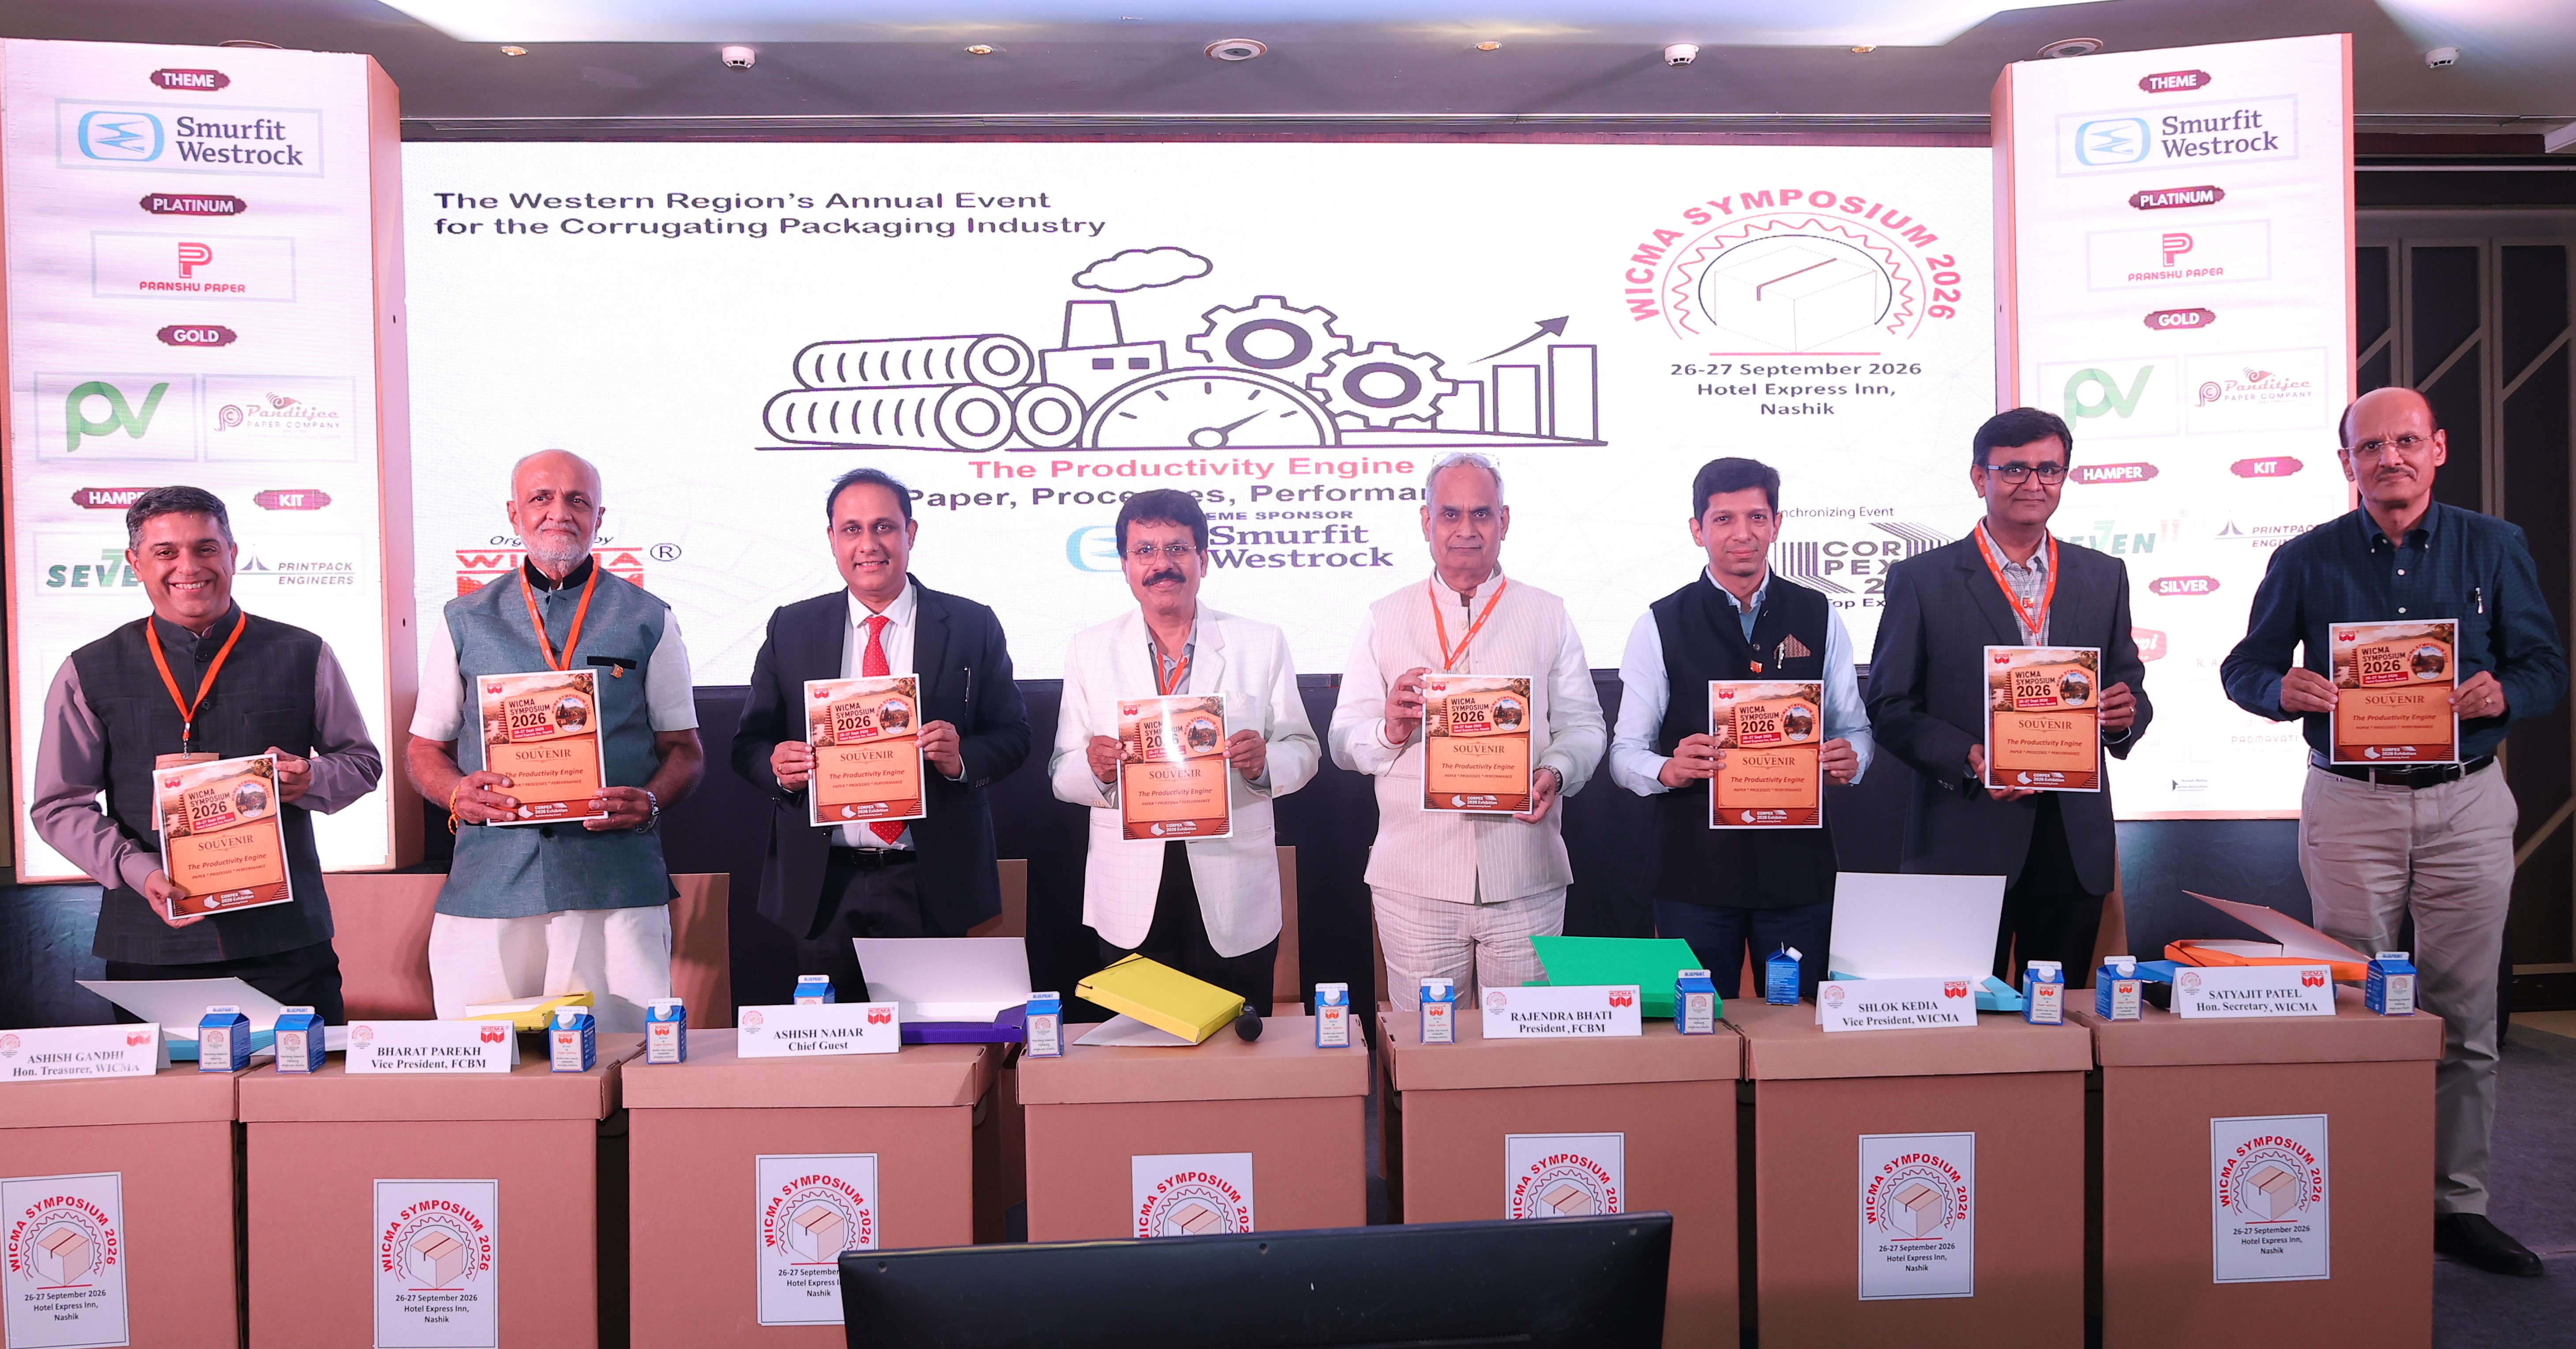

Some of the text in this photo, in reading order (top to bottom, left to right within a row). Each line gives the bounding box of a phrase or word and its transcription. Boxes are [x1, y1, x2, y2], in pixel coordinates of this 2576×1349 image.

[163, 73, 214, 87] THEME
[2149, 75, 2197, 88] THEME
[176, 116, 286, 141] Smurfit
[2162, 110, 2263, 135] Smurfit
[2162, 132, 2279, 158] Westrock
[176, 141, 303, 165] Westrock
[434, 193, 498, 208] The
[509, 193, 653, 208] Western
[826, 193, 942, 208] Annual
[956, 193, 1051, 208] Event
[2140, 190, 2213, 207] PLATINUM
[153, 198, 234, 213] PLATINUM
[434, 218, 1105, 238] for the Corrugating Packaging Industry
[1625, 189, 1960, 322] WICMA SYMPOSIUM 2026
[2128, 267, 2223, 281] PRANSHU PAPER
[140, 282, 245, 293] PRANSHU PAPER
[2158, 313, 2200, 326] GOLD
[174, 330, 219, 342] GOLD
[1671, 363, 1922, 378] 26-27 September 2026
[1698, 383, 1896, 397] Hotel Express Inn,
[1761, 403, 1834, 415] Nashik
[969, 457, 1414, 479] The Productivity Engine
[2084, 467, 2143, 479] HAMPER
[2254, 462, 2277, 473] KIT
[279, 494, 304, 507] KIT
[910, 488, 1017, 510] Paper,
[1256, 511, 1353, 520] SPONSOR
[1859, 507, 1894, 516] Event
[1210, 525, 1369, 546] Smurfit
[1823, 541, 1901, 557] COR
[1208, 548, 1393, 568] Westrock
[278, 563, 353, 571] PRINTPACK
[278, 576, 354, 585] ENGINEERS
[2160, 580, 2208, 592] SILVER
[2362, 646, 2389, 655] WICMA
[2362, 652, 2405, 662] SYMPOSIUM
[2364, 660, 2400, 674] 2026
[2017, 684, 2050, 697] 2026
[509, 699, 535, 707] WICMA
[2365, 695, 2425, 704] SOUVENIR
[511, 705, 550, 715] SYMPOSIUM
[835, 703, 860, 712] WICMA
[837, 708, 875, 719] SYMPOSIUM
[511, 712, 546, 728] 2026
[1453, 711, 1484, 723] 2026
[1740, 712, 1780, 721] SYMPOSIUM
[837, 716, 871, 731] 2026
[1741, 720, 1775, 733] 2026
[2019, 720, 2072, 729] SOUVENIR
[516, 749, 571, 760] SOUVENIR
[841, 751, 894, 762] SOUVENIR
[1149, 769, 1201, 779] SOUVENIR
[188, 789, 215, 800] WICMA
[190, 793, 230, 807] SYMPOSIUM
[192, 801, 227, 819] 2026
[199, 834, 254, 851] SOUVENIR
[2209, 989, 2302, 1000] SATYAJIT PATEL
[1859, 1001, 1938, 1013] SHLOK KEDIA
[2197, 1003, 2220, 1011] Hon.
[2276, 1002, 2317, 1012] WICMA
[1511, 1011, 1612, 1021] RAJENDRA BHATI
[1842, 1014, 1959, 1026] Vice President, WICMA
[773, 1028, 863, 1040] ASHISH NAHAR
[377, 1047, 481, 1056] BHARAT PAREKH
[789, 1041, 848, 1051] Chief Guest
[27, 1052, 72, 1064] ASHISH
[75, 1051, 124, 1061] GANDHI
[13, 1063, 139, 1077] Hon. Treasurer, WICMA
[372, 1059, 486, 1070] Vice President, FCBM
[1531, 1154, 1611, 1184] SYMPOSIUM
[2219, 1136, 2321, 1207] WICMA SYMPOSIUM 2026
[1157, 1172, 1242, 1203] SYMPOSIUM
[1866, 1153, 1968, 1224] WICMA SYMPOSIUM 2026
[764, 1175, 871, 1248] WICMA SYMPOSIUM 2026
[9, 1196, 117, 1273] WICMA SYMPOSIUM 2026
[382, 1200, 491, 1272] WICMA SYMPOSIUM 2026
